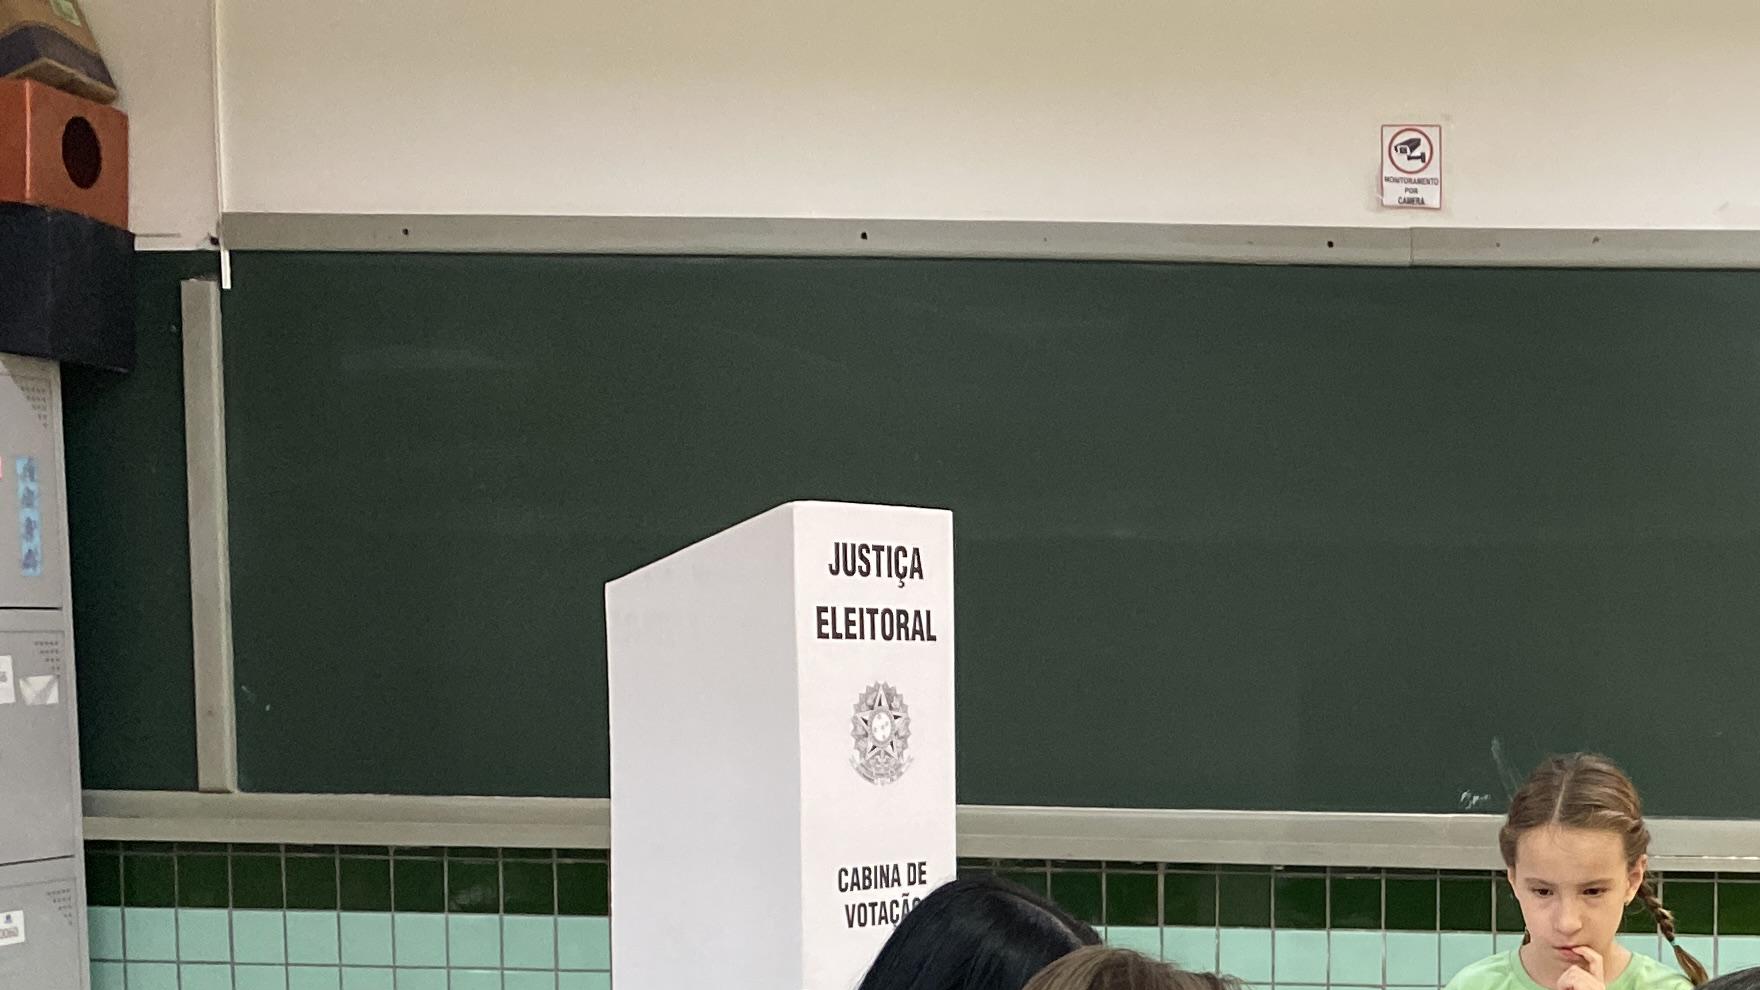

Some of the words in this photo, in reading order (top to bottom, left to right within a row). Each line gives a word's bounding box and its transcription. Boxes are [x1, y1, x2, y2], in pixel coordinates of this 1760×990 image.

[828, 542, 924, 588] JUSTIÇA
[816, 606, 937, 641] ELEITORAL
[838, 863, 901, 893] CABINA
[907, 861, 927, 886] DE
